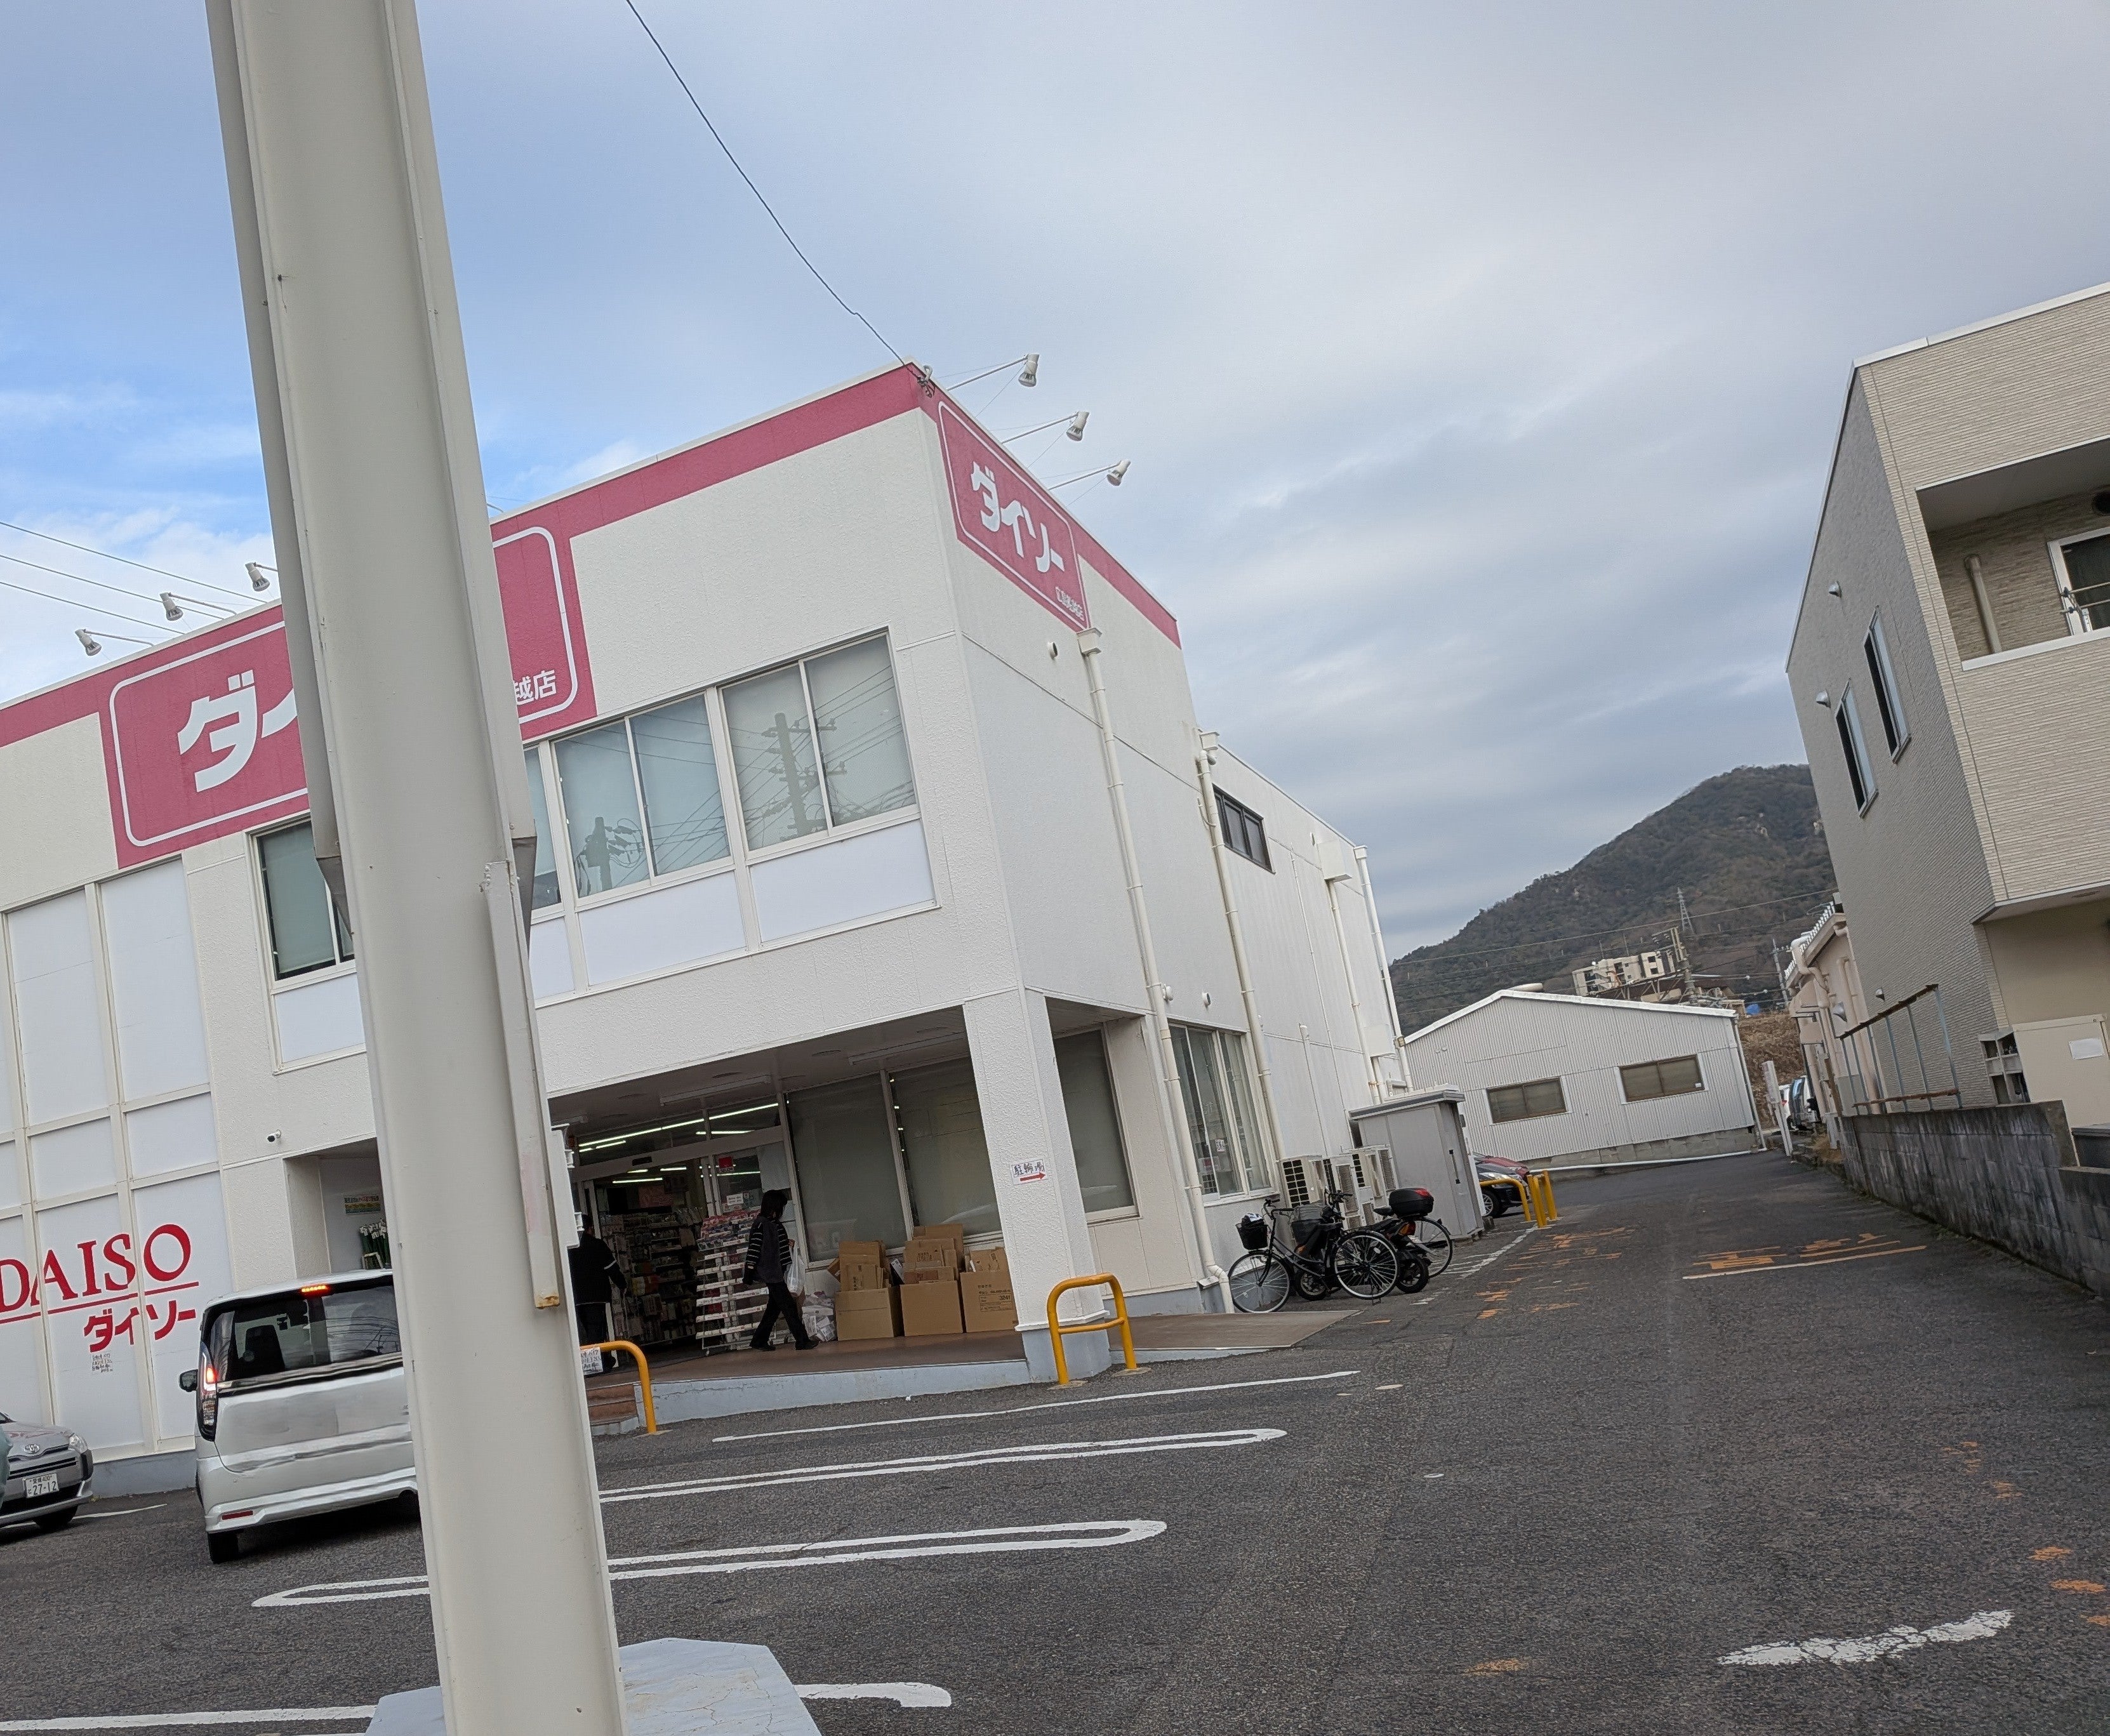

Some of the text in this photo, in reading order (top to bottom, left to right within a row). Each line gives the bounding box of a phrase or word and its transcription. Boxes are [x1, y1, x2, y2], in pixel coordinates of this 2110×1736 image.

[971, 461, 1065, 573] ダイソー
[1014, 1162, 1045, 1176] 駐輪場
[0, 1224, 191, 1313] DAISO
[84, 1300, 196, 1353] ダイソー
